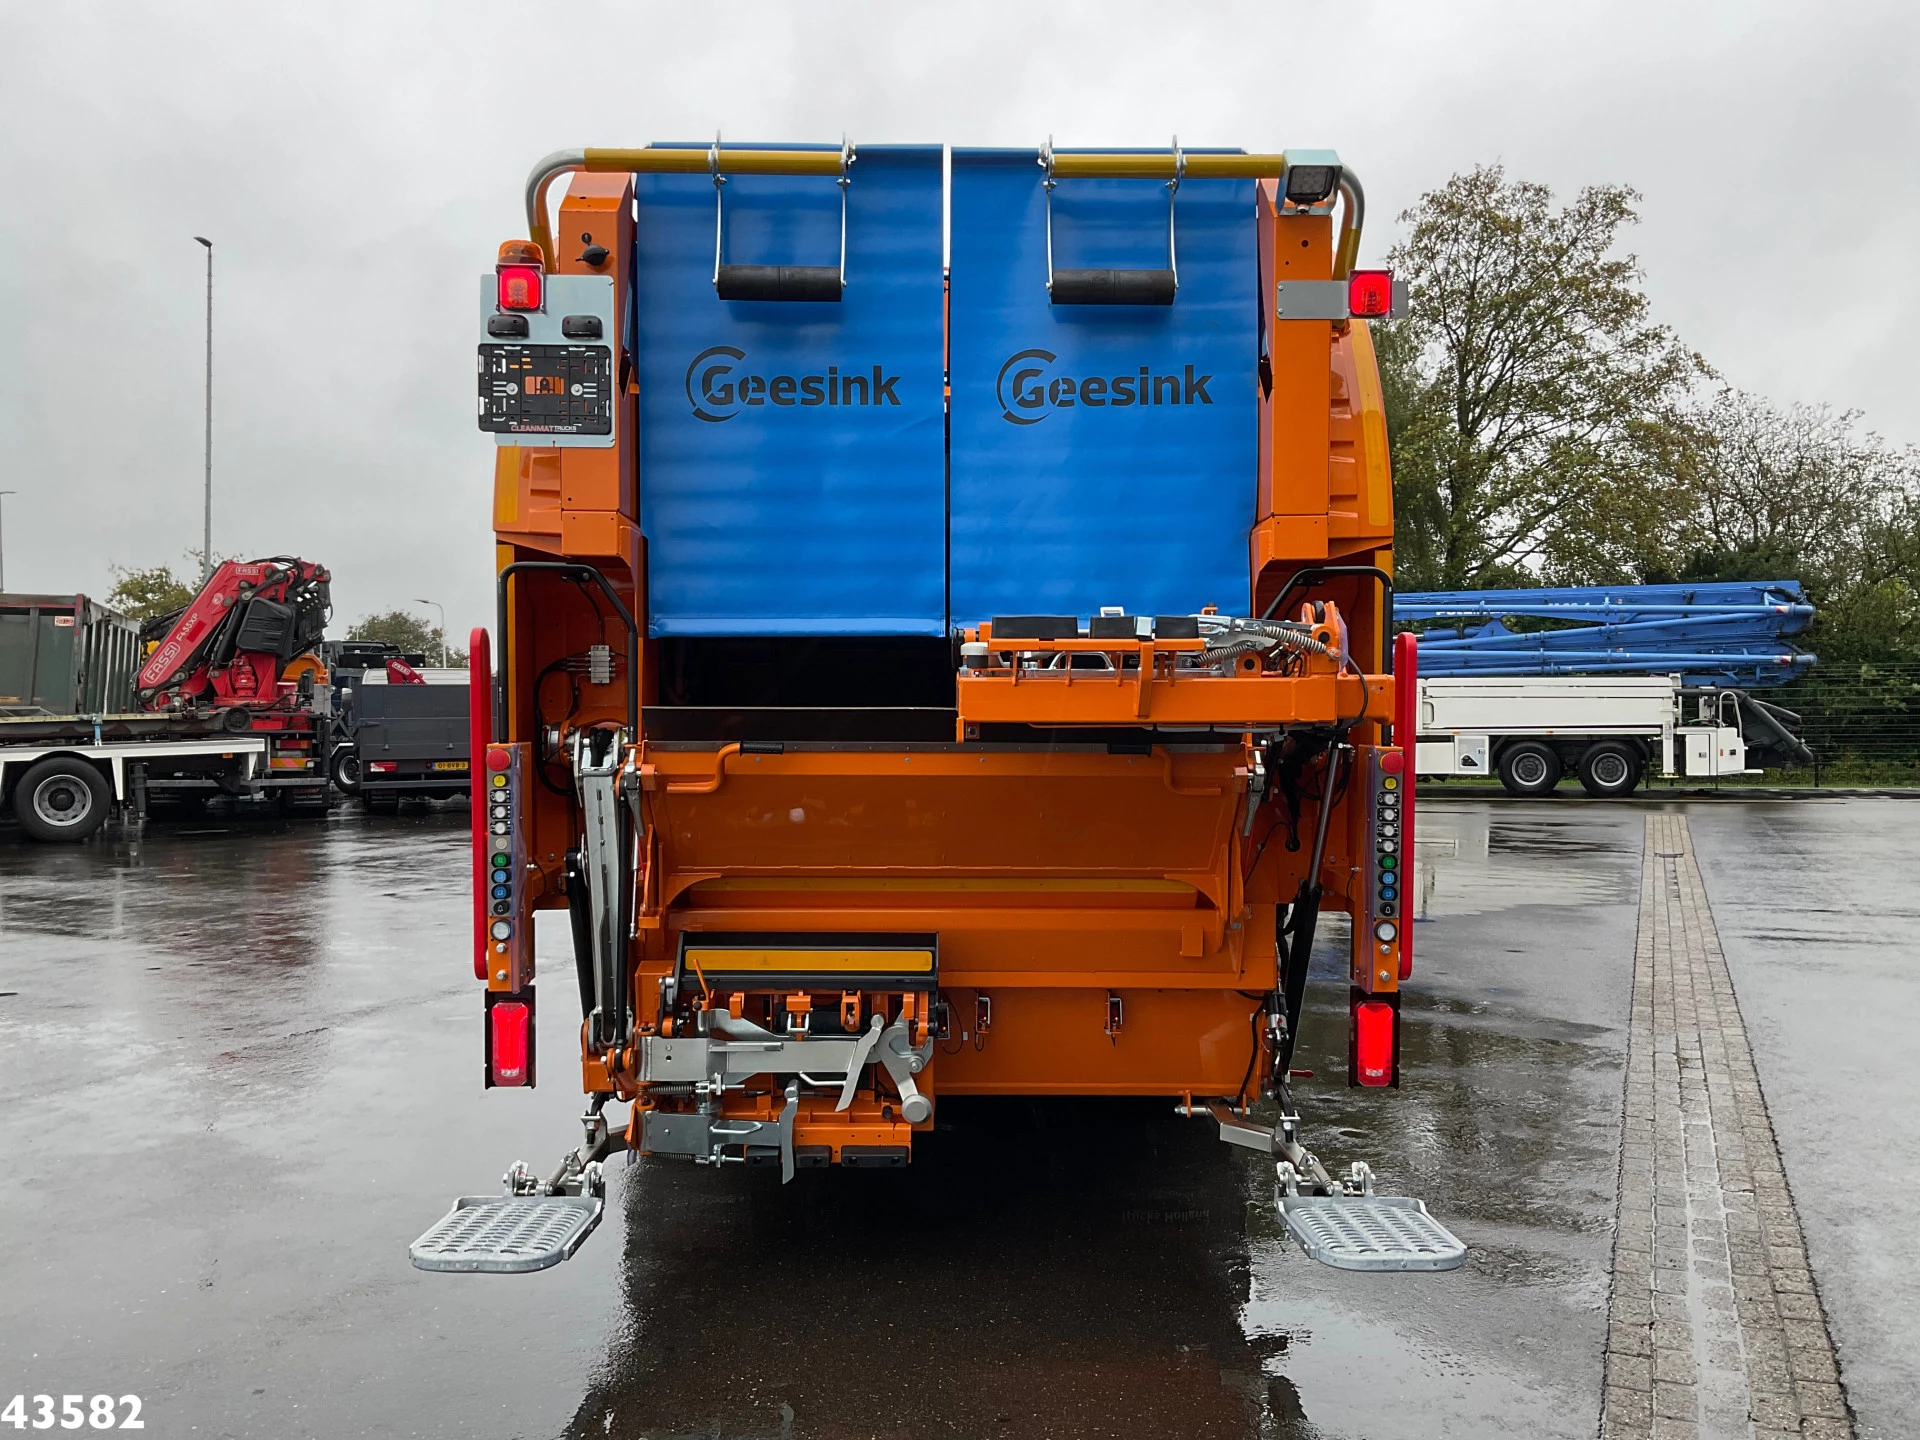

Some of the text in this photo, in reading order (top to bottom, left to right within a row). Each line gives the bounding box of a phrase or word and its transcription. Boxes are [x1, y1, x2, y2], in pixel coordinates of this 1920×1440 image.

[698, 361, 903, 409] Geesink
[1010, 361, 1215, 410] Geesink
[146, 645, 180, 682] FASSI
